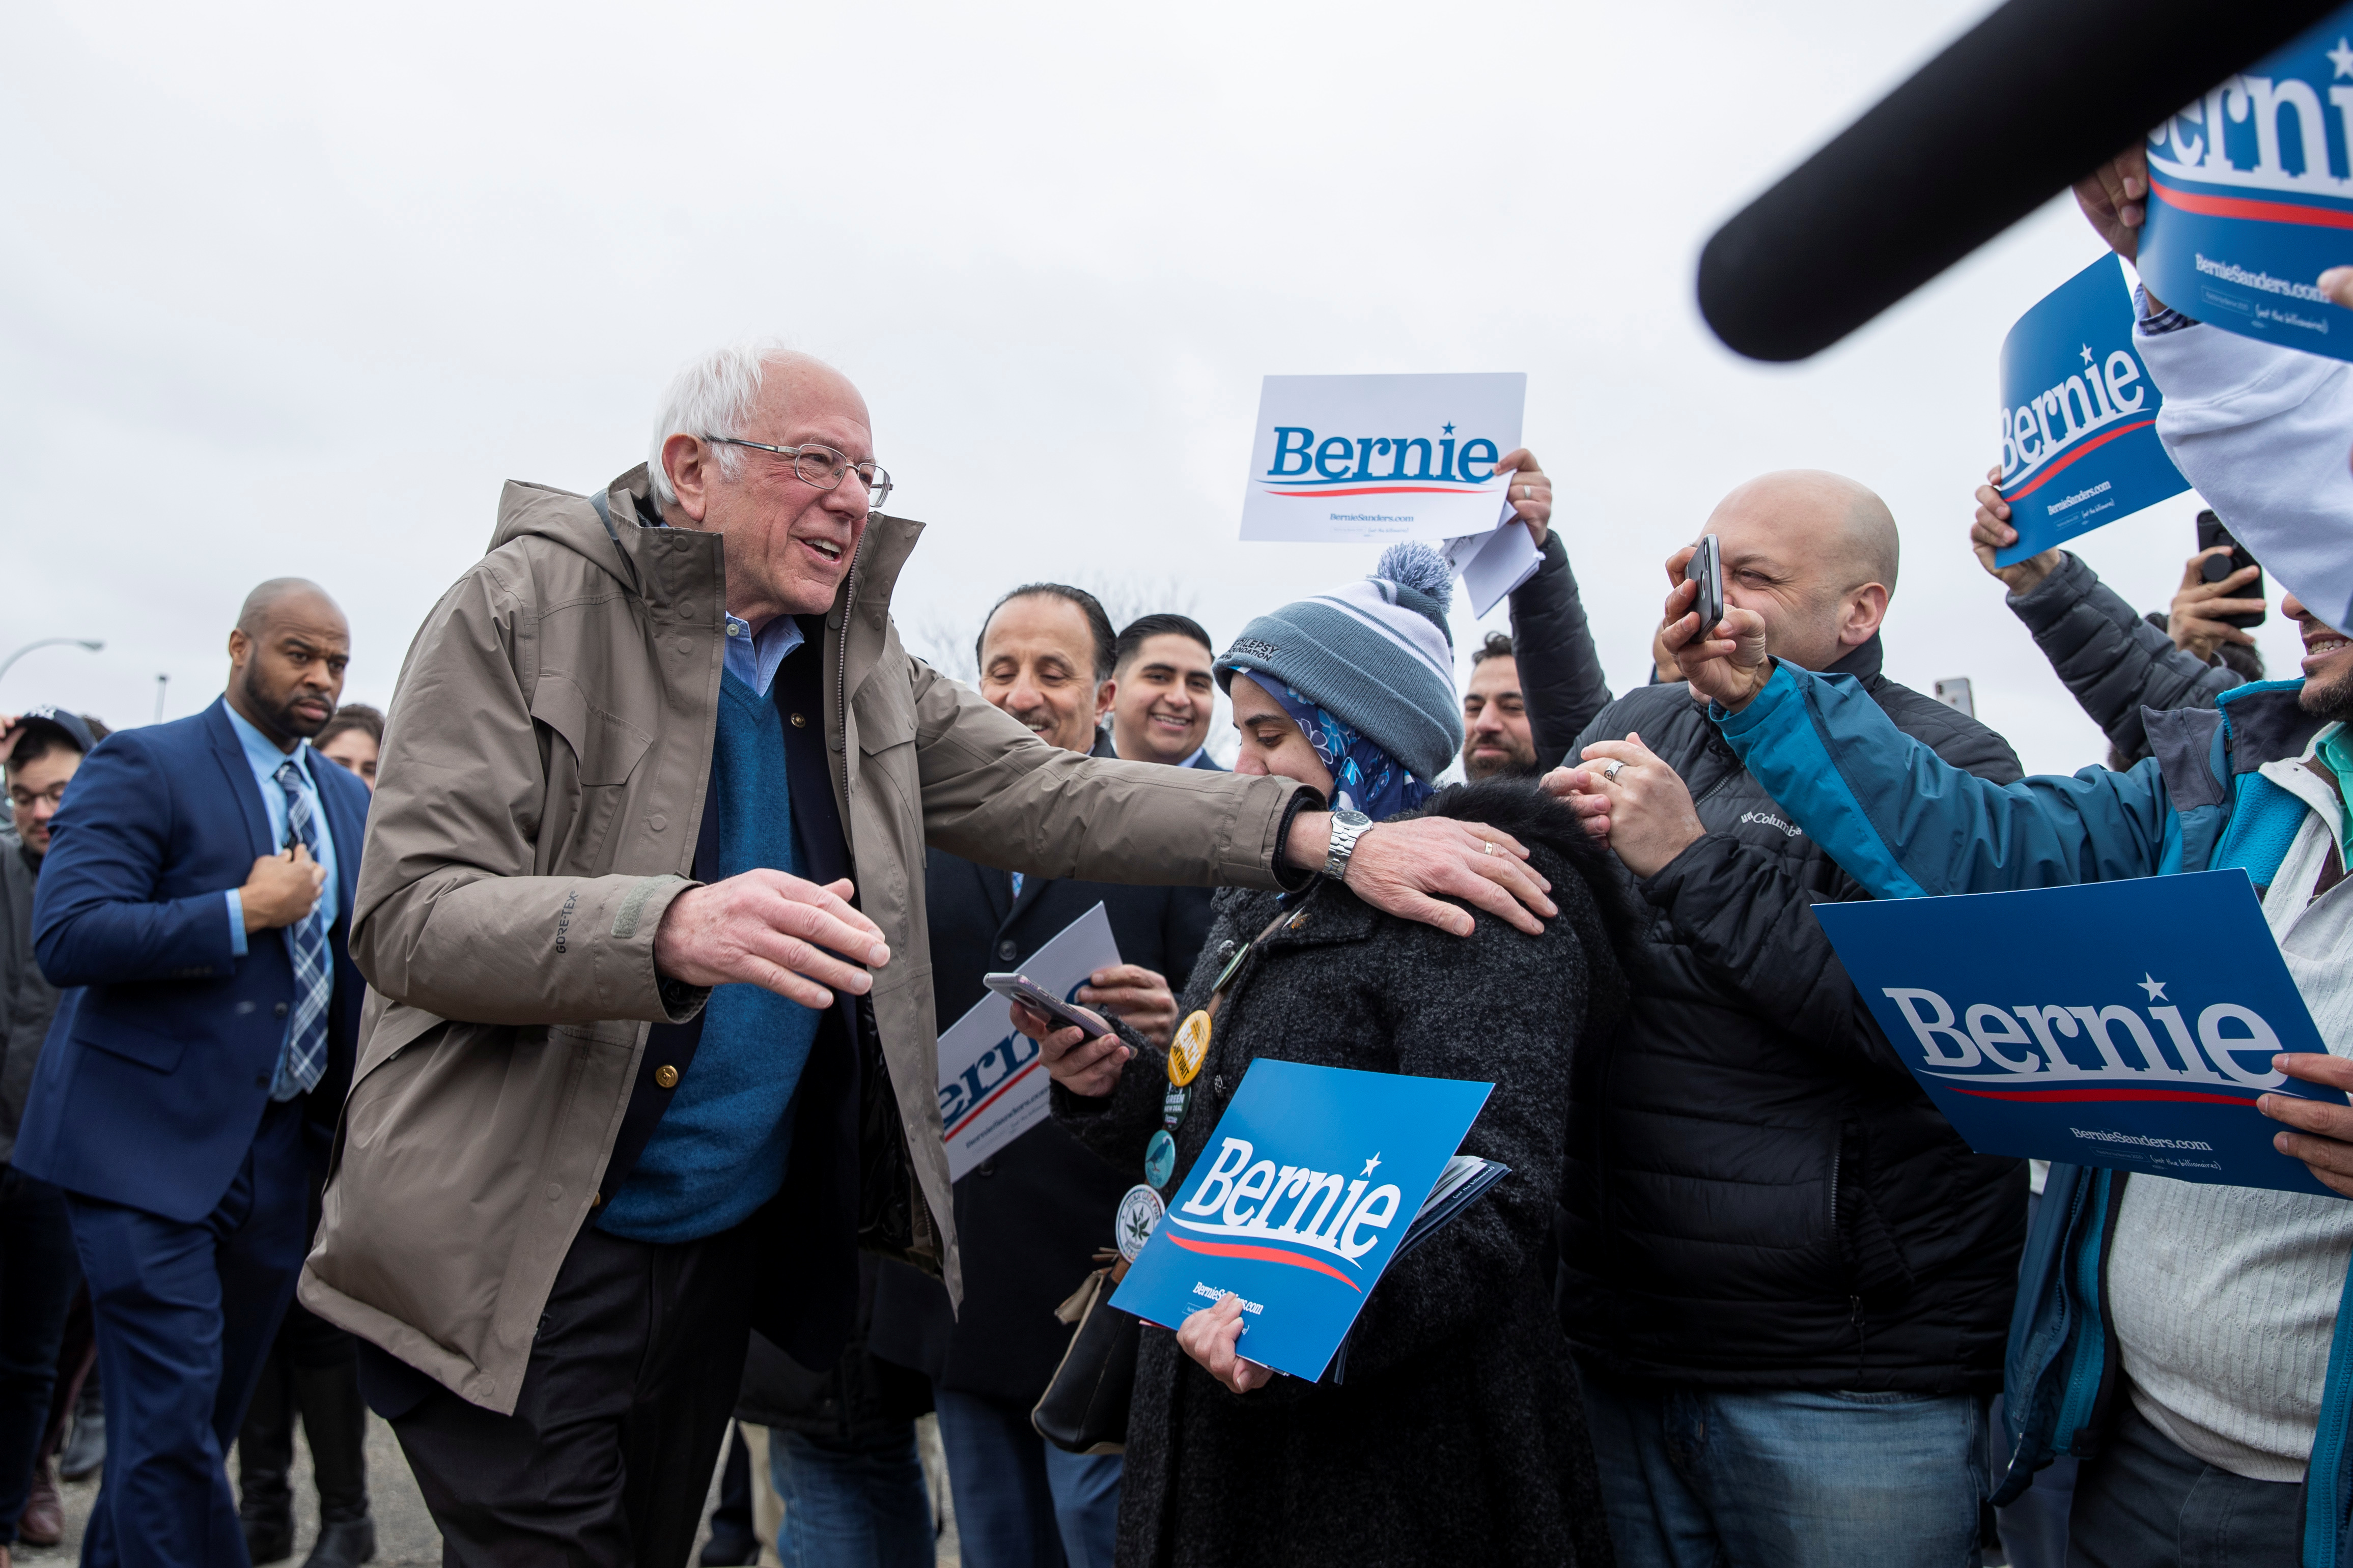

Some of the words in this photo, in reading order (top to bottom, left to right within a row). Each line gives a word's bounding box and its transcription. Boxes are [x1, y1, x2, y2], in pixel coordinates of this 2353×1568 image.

[2001, 343, 2144, 477] Bernie
[1267, 421, 1499, 482] Bernie
[1330, 514, 1414, 522] BernieSanders.com
[1228, 647, 1272, 662] OUNDATION
[1231, 639, 1280, 654] EPILEPSY
[1753, 813, 1802, 837] Columba
[1882, 972, 2288, 1089] Bernie
[1166, 1094, 1185, 1104] GREEN
[2069, 1127, 2213, 1151] BernieSanders.com
[1182, 1137, 1401, 1259] Bernie
